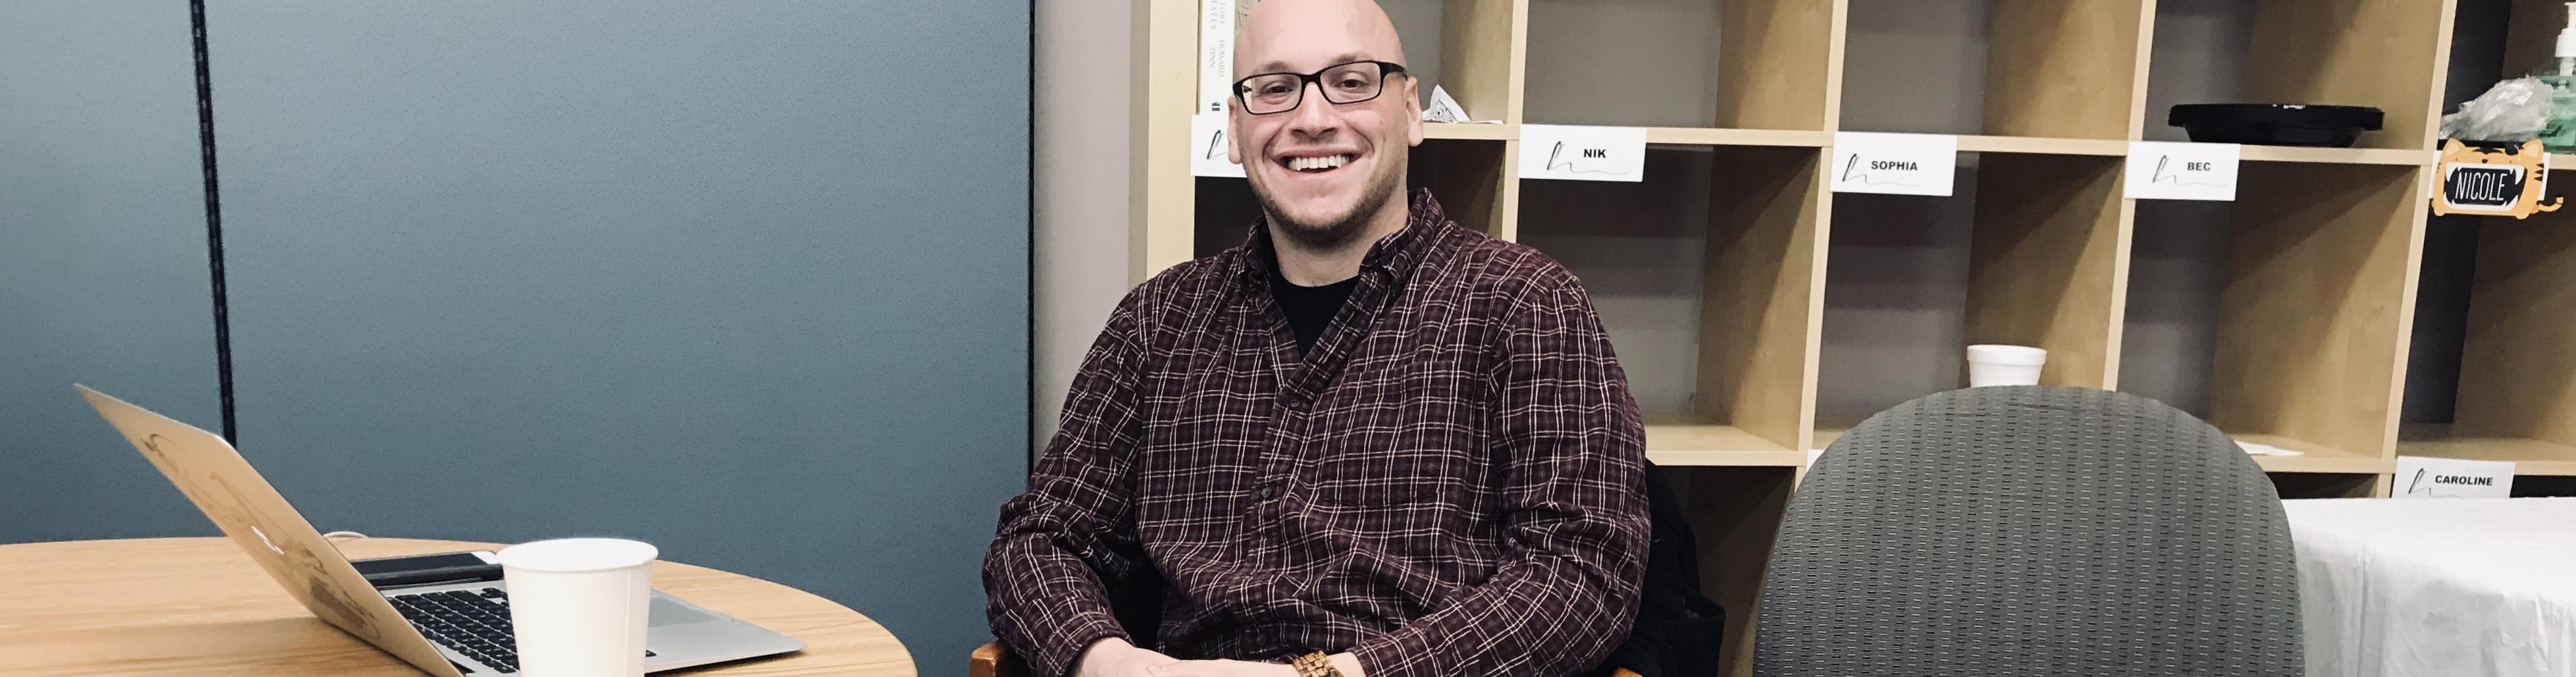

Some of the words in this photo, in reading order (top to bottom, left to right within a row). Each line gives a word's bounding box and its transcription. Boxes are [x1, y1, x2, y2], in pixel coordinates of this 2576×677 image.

[1583, 148, 1606, 159] NIK
[1871, 161, 1918, 171] SOPHIA
[2187, 162, 2211, 171] BEC
[2455, 171, 2508, 202] NICOLE
[2435, 475, 2494, 486] CAROLINE
